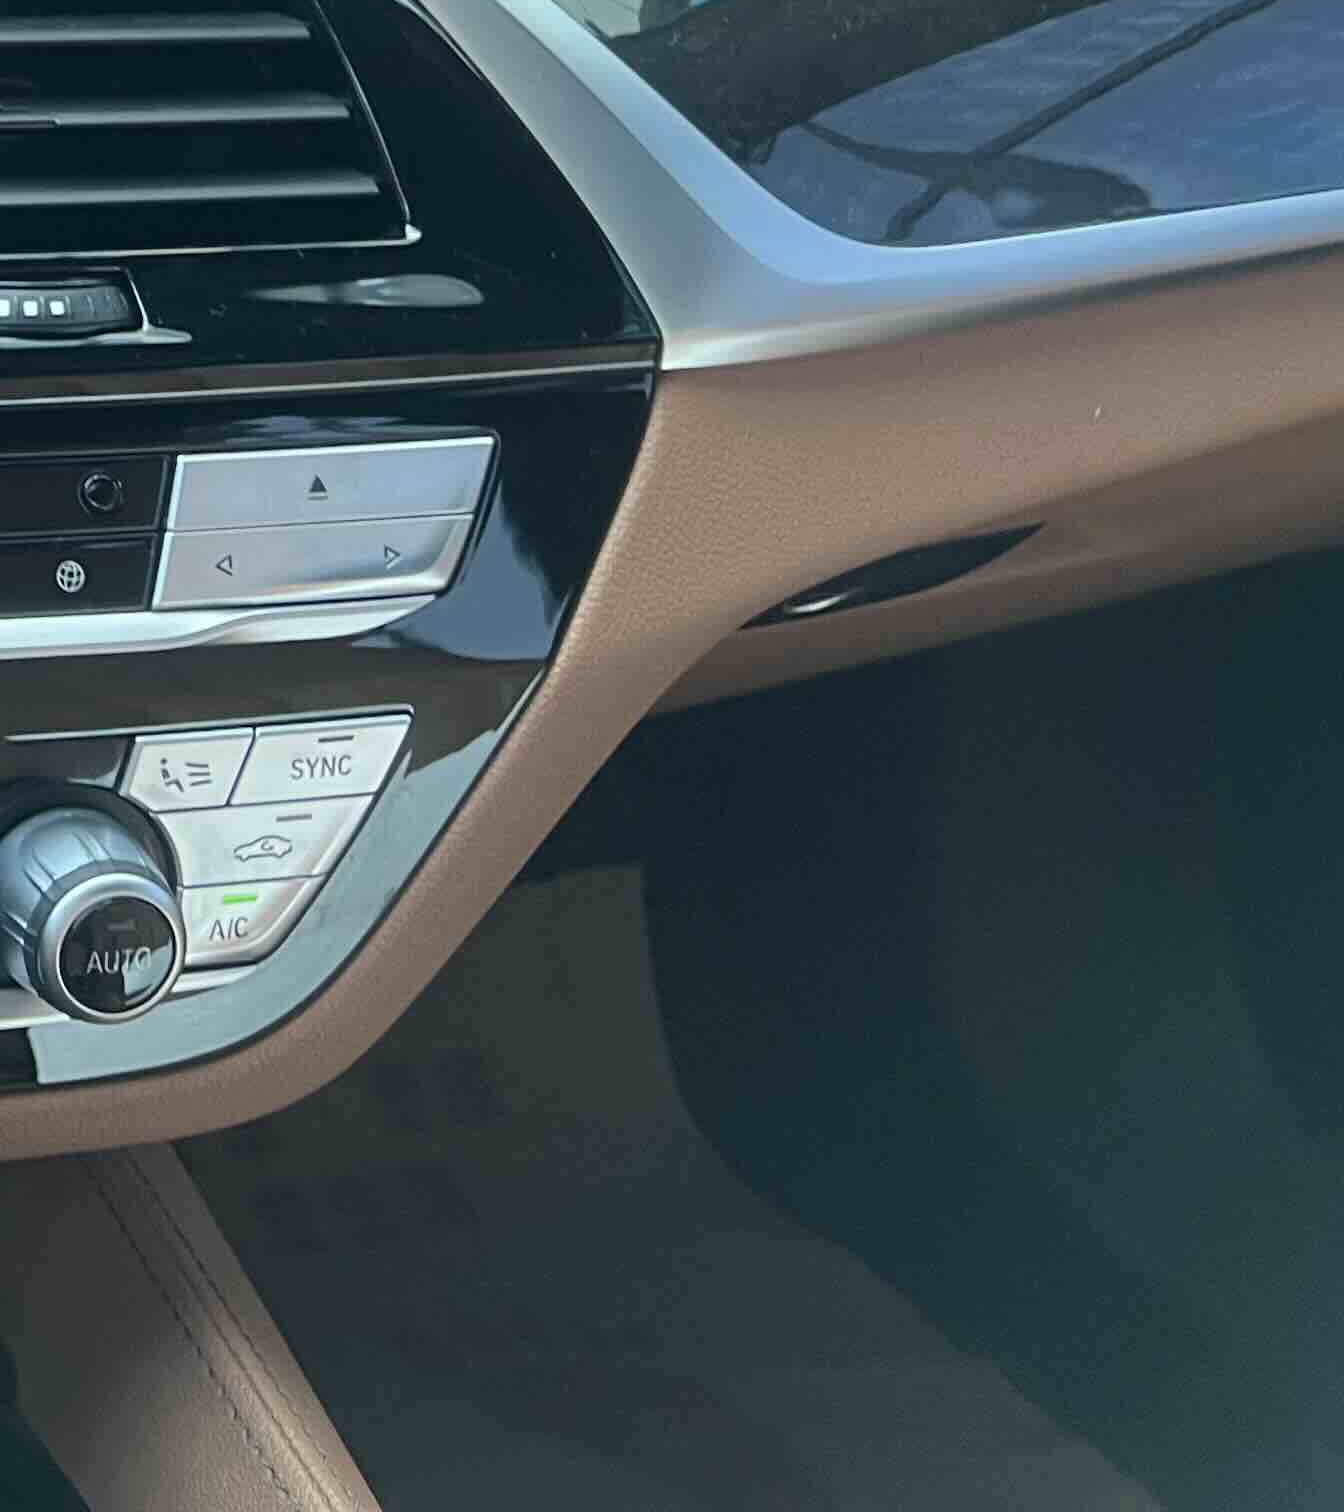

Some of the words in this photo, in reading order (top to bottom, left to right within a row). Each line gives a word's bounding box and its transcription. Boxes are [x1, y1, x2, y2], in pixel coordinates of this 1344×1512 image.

[289, 753, 353, 781] SYNC
[208, 916, 249, 941] A/C
[86, 946, 152, 974] AUTO
